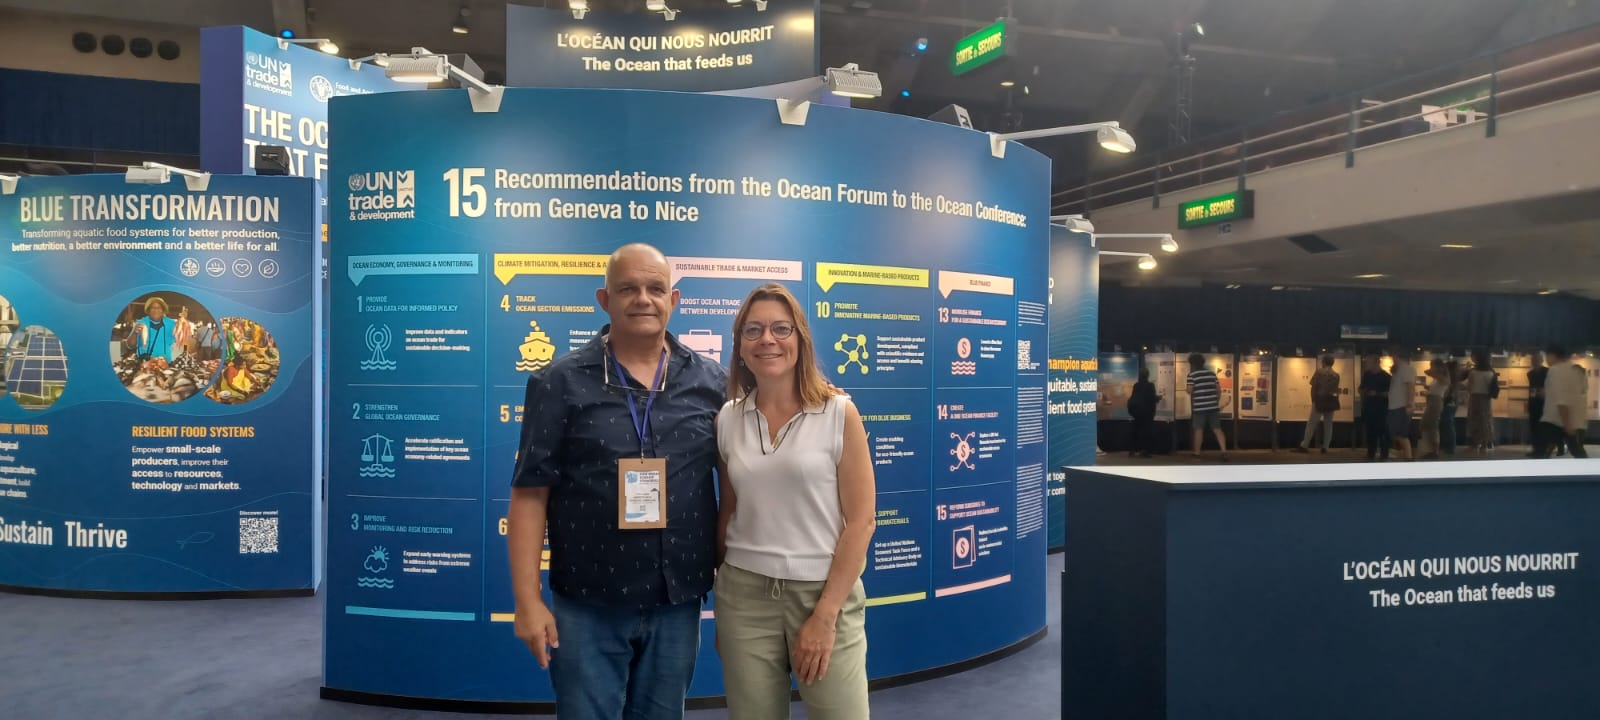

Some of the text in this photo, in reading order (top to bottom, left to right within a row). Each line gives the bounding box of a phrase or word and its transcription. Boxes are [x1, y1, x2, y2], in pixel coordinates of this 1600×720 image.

[557, 25, 774, 52] L'OCÉAN QUI NOUS NOURRIT
[258, 56, 278, 72] UN
[582, 53, 752, 72] The Ocean that feeds us
[246, 64, 279, 85] trade
[252, 81, 292, 96] development
[244, 104, 292, 142] THE
[366, 171, 393, 190] UN
[348, 192, 394, 210] trade
[444, 168, 487, 218] 15
[495, 168, 682, 192] Recommendations
[689, 174, 734, 194] from
[741, 176, 772, 197] the
[778, 178, 832, 202] Ocean
[838, 184, 888, 207] Forum
[892, 189, 906, 208] to
[910, 192, 932, 212] the
[936, 196, 972, 217] Ocean
[20, 195, 280, 222] BLUE TRANSFORMATION
[495, 198, 699, 222] from Geneva to Nice
[1210, 198, 1235, 216] SECOURS
[350, 210, 414, 221] & development
[22, 228, 280, 240] Transforming aquatic food systems for better production,
[12, 242, 32, 252] better
[76, 241, 100, 250] better
[104, 241, 162, 250] environment
[165, 241, 183, 250] and
[194, 241, 225, 250] better
[227, 242, 244, 250] life
[246, 242, 261, 251] for
[264, 242, 280, 252] all.
[676, 263, 716, 271] SUSTAINABLE
[766, 266, 788, 274] ACCESS
[357, 296, 362, 312] 1
[500, 294, 510, 312] 4
[701, 298, 720, 306] OCEAN
[816, 301, 830, 318] 10
[938, 308, 950, 322] 13
[352, 402, 360, 420] 2
[500, 405, 510, 422] 5
[938, 404, 948, 420] 14
[1068, 401, 1082, 414] food
[32, 424, 48, 435] LESS
[132, 426, 255, 438] RESILIENT FOOD SYSTEMS
[132, 444, 222, 454] Empower small-scale
[132, 457, 229, 466] producers, improve their
[132, 470, 224, 479] access to resources,
[132, 481, 242, 492] technology and markets.
[936, 505, 946, 520] 15
[350, 514, 359, 530] 3
[422, 526, 452, 534] REDUCTION
[498, 518, 508, 536] 6
[65, 521, 128, 549] Thrive
[1343, 552, 1579, 580] L'OCÉAN QUI NOUS NOURRIT
[1370, 582, 1556, 608] The Ocean that feeds us
